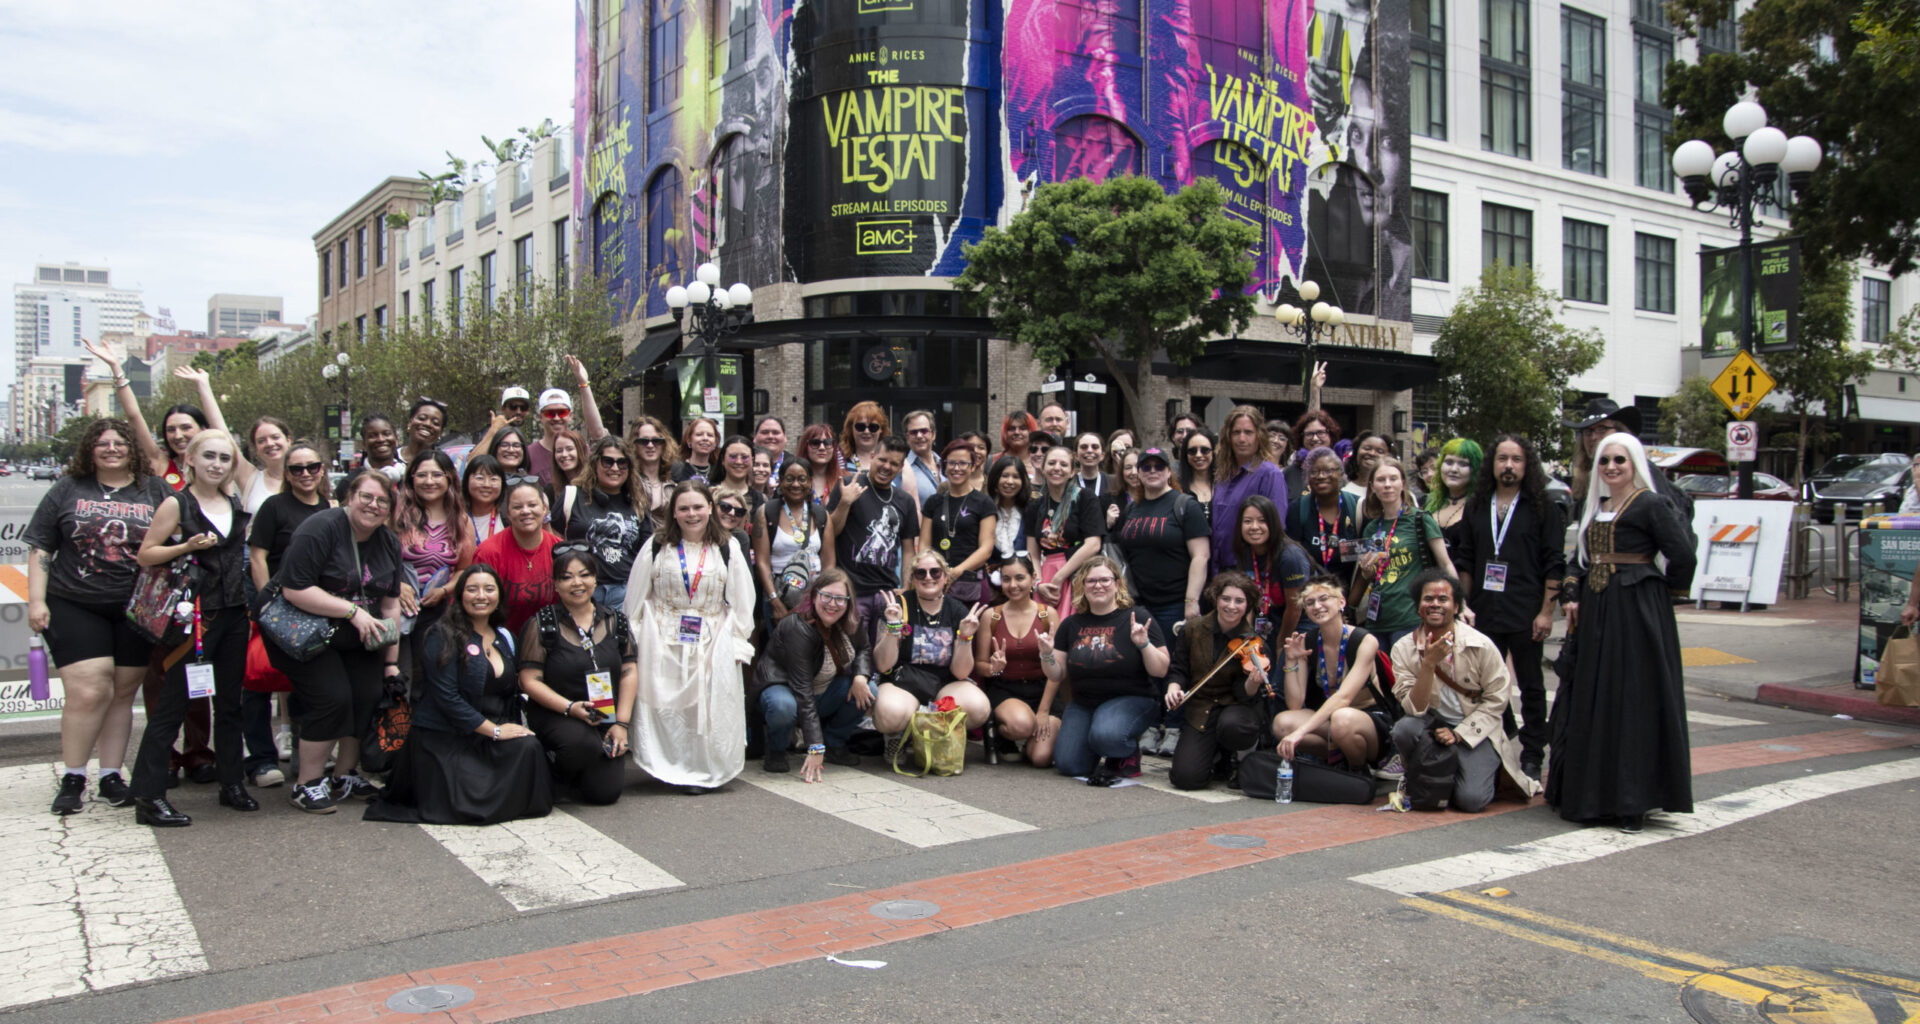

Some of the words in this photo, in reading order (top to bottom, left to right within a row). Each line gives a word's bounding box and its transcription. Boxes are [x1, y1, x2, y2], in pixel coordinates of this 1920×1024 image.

[849, 51, 876, 63] ANNE
[1237, 47, 1259, 66] ANNE
[868, 69, 899, 84] THE
[1249, 72, 1279, 94] THE
[821, 86, 964, 147] VAMPIRE
[1205, 63, 1315, 167] VAMPIRE
[840, 133, 944, 194] LESTAT
[831, 201, 870, 217] STREAM
[872, 200, 891, 213] ALL
[894, 199, 948, 213] EPISODES
[1233, 192, 1248, 208] ALL
[1249, 198, 1293, 227] EPISODES
[1761, 263, 1790, 275] ARTS
[1880, 540, 1897, 550] SAN
